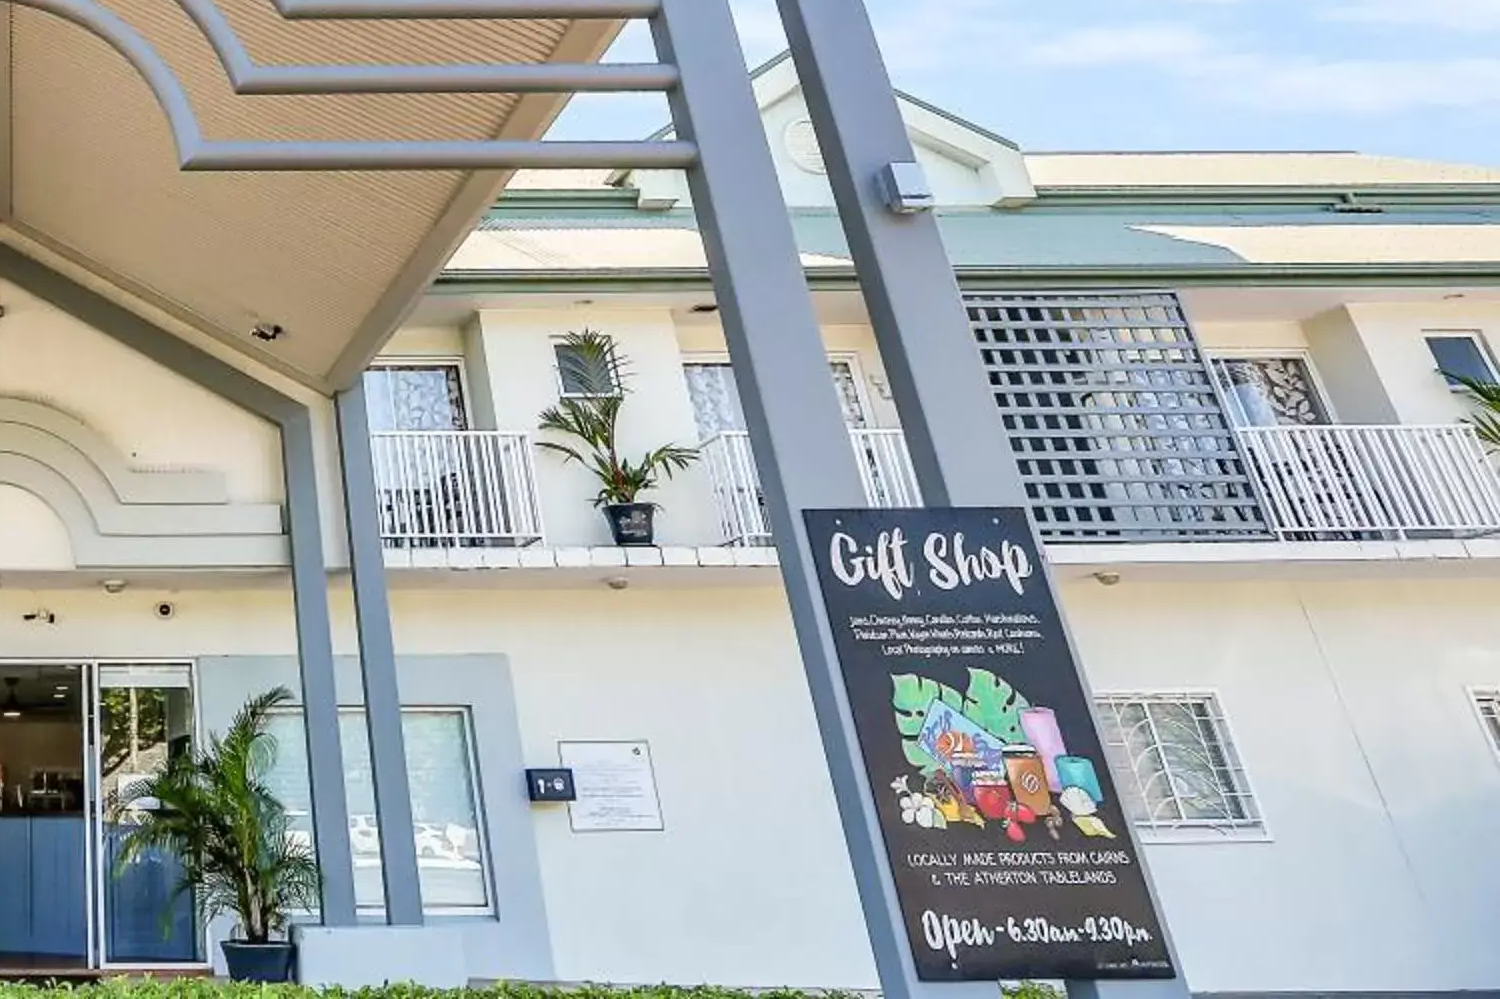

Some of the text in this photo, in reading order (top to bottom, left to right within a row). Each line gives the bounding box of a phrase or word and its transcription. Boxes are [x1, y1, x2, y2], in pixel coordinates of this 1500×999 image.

[830, 527, 1034, 600] Gift Shop
[907, 851, 1130, 867] LOCALLY MADE PRODUCTS FROM CAIRNS
[944, 872, 971, 886] THE
[974, 871, 1037, 885] ATHERTON
[1040, 870, 1117, 884] TABLELANDS
[922, 910, 995, 959] Open
